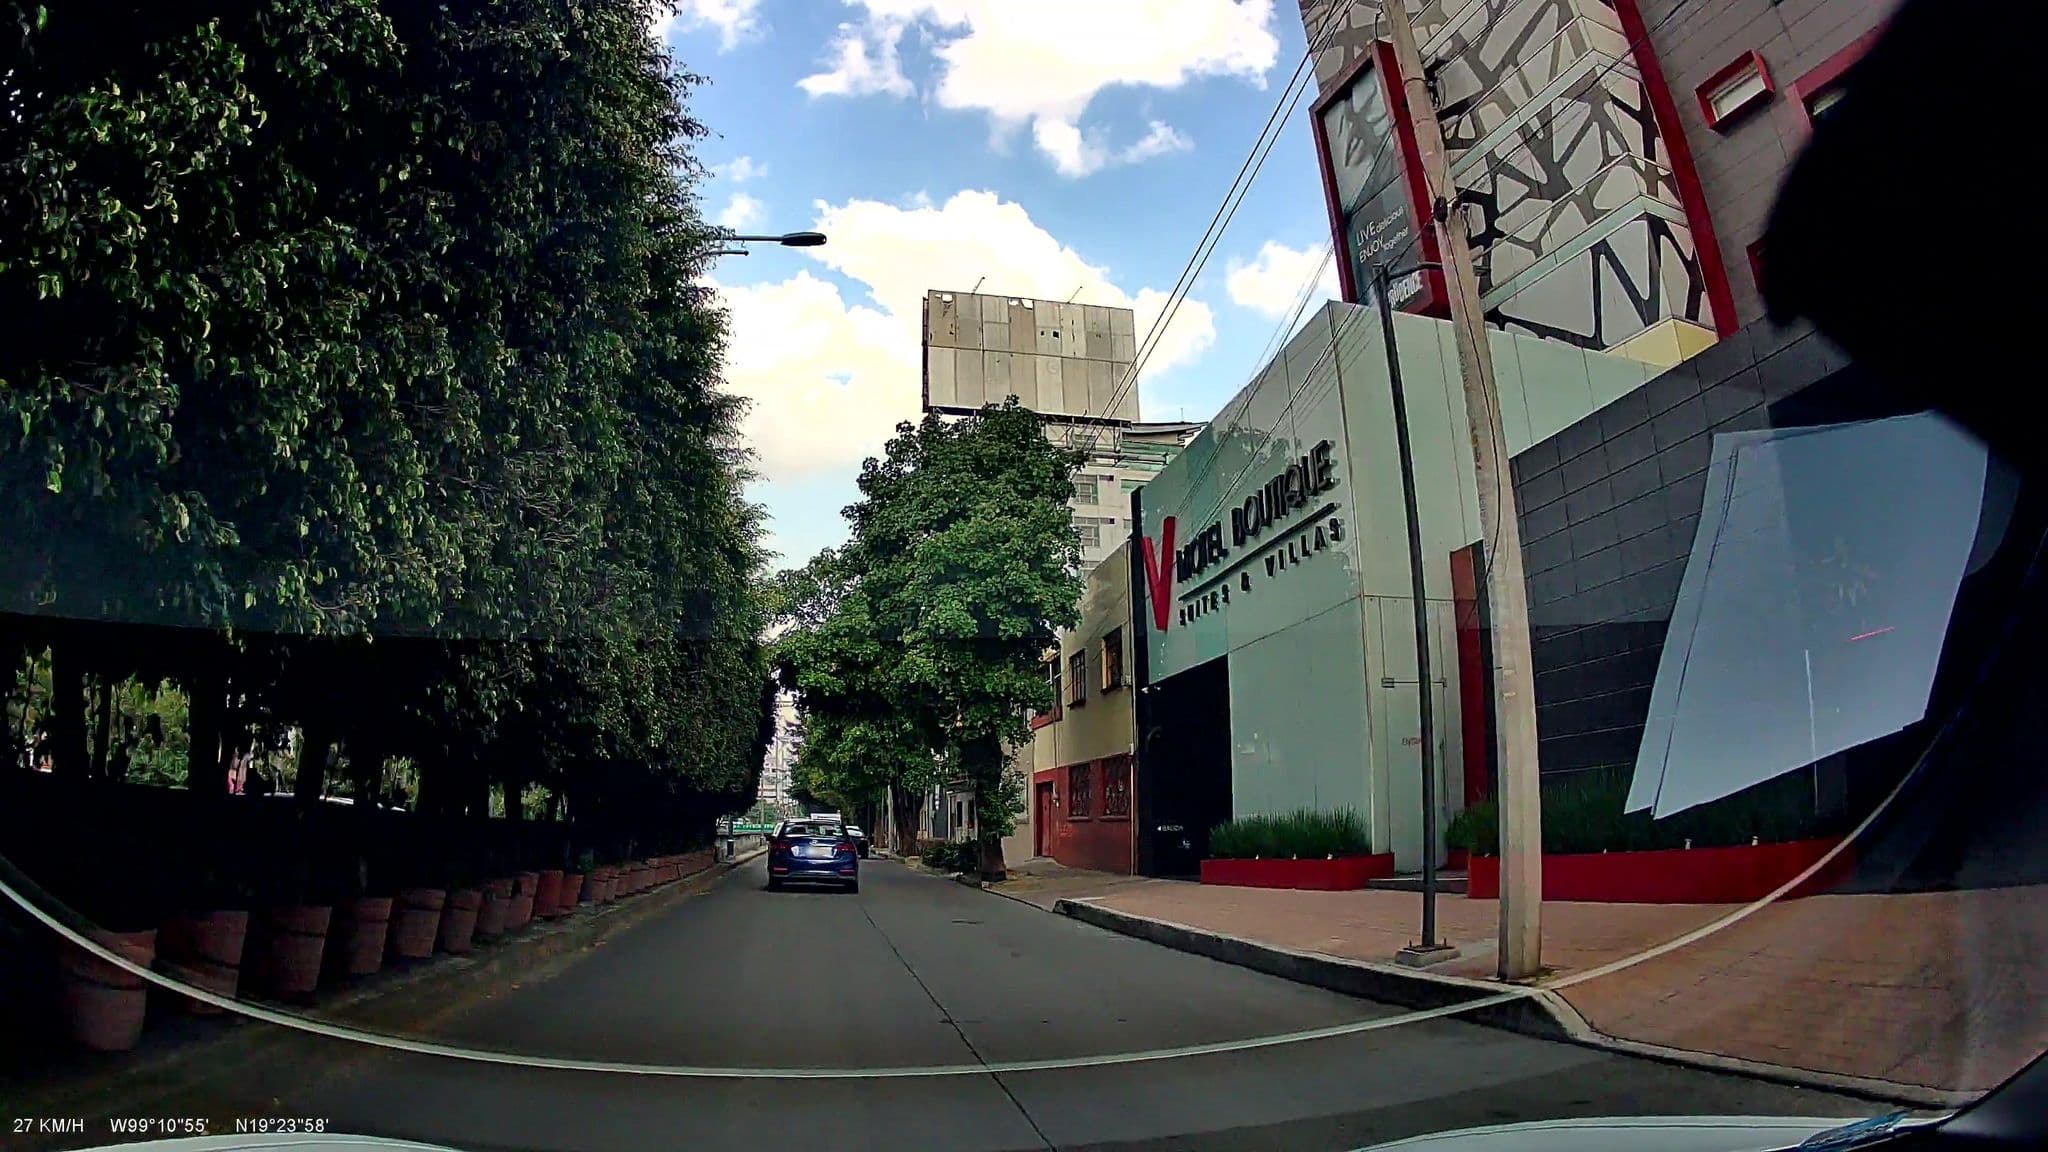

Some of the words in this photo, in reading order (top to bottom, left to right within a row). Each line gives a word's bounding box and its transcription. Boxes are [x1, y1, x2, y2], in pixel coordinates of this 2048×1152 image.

[1356, 221, 1376, 246] LIVE
[1359, 236, 1384, 263] ENJOY
[1231, 439, 1338, 546] BOUTIQUE
[1141, 516, 1176, 631] V
[1179, 584, 1231, 626] SUITES
[1264, 517, 1344, 577] VILLAS
